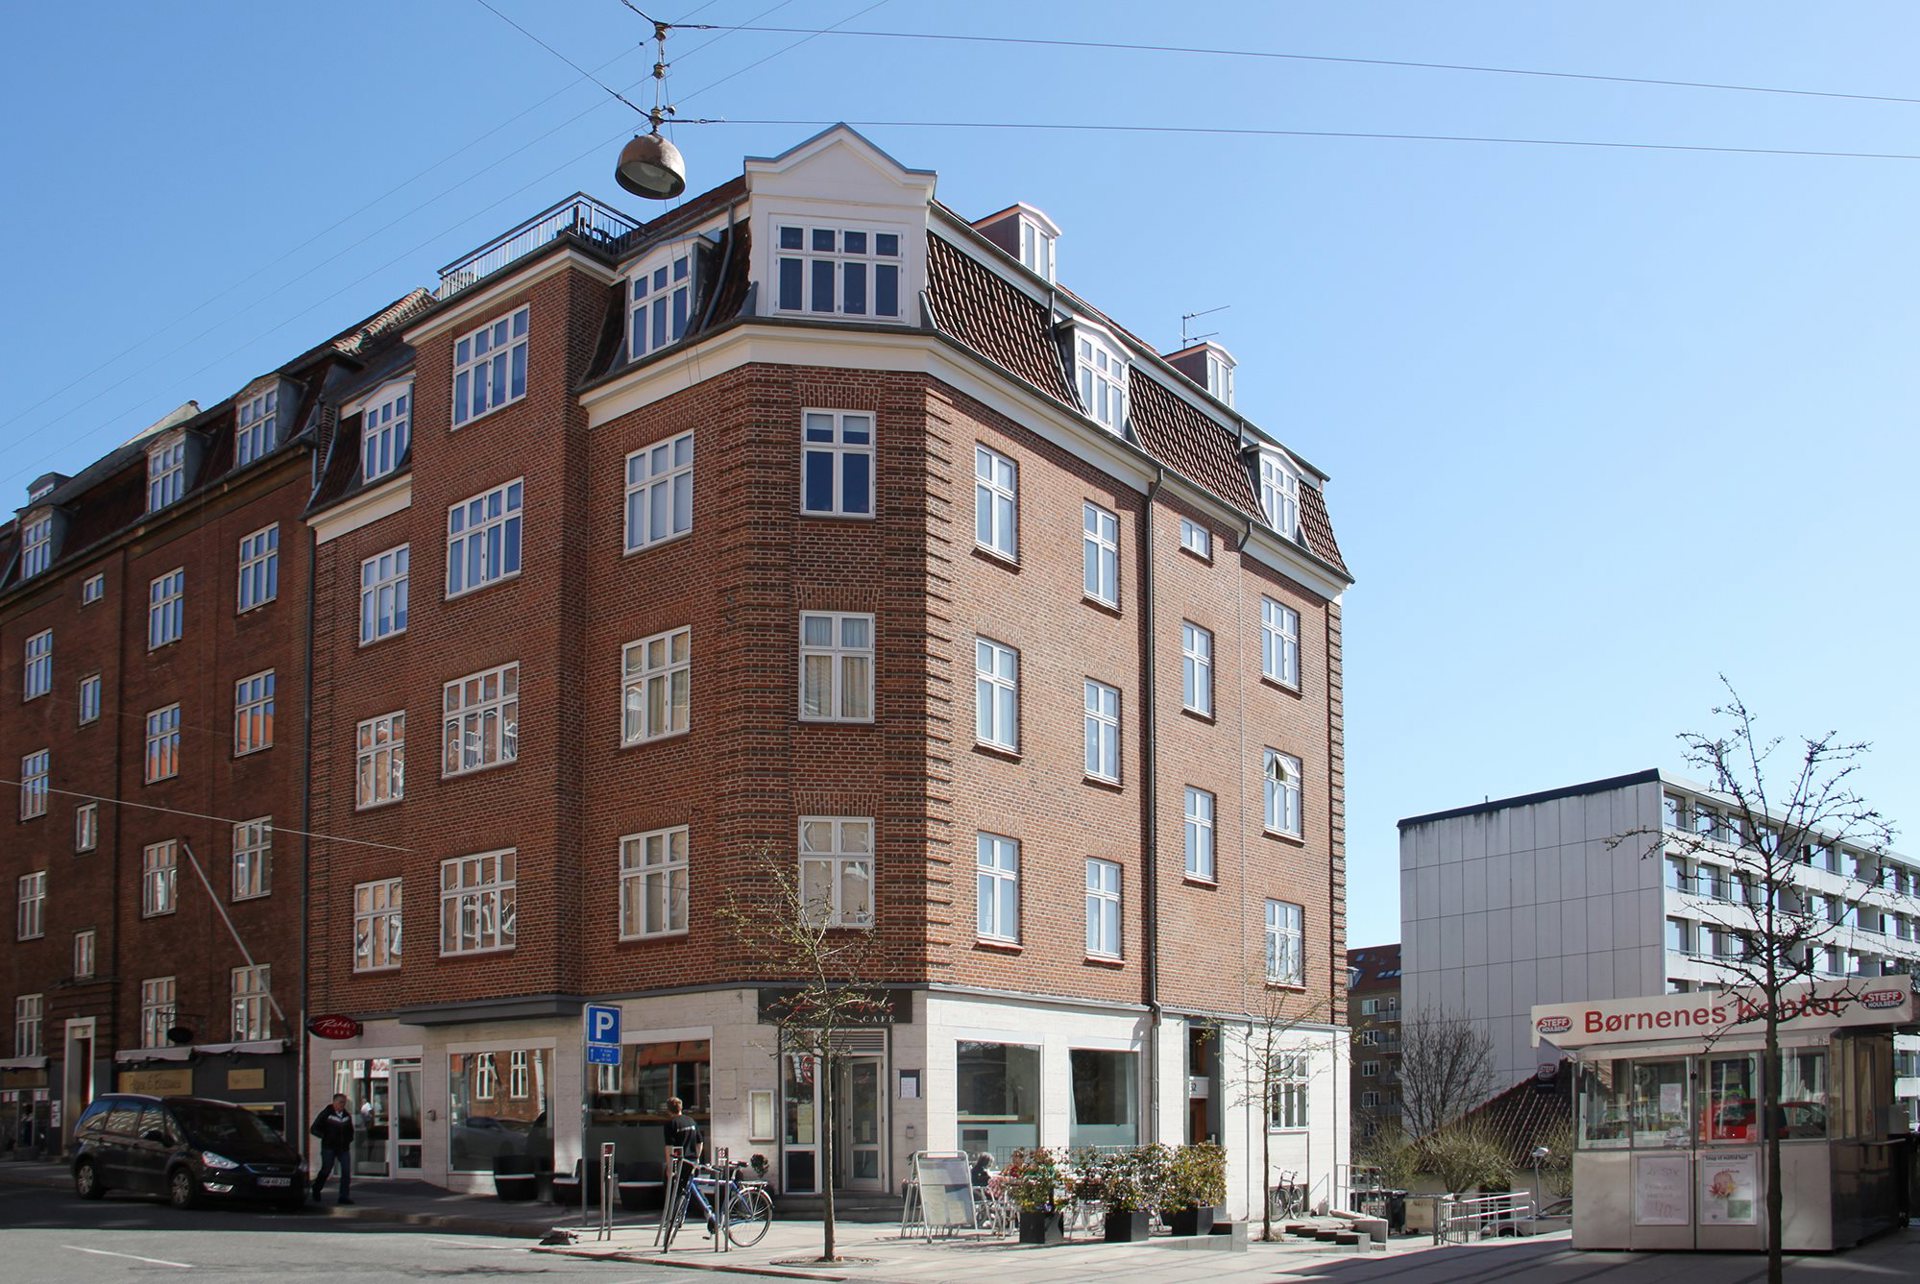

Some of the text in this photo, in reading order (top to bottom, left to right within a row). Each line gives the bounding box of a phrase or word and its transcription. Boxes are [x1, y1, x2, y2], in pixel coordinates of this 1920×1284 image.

[1867, 991, 1899, 1002] STEFF
[596, 1011, 615, 1040] P
[1541, 1018, 1568, 1027] STEFF
[1584, 1004, 1727, 1033] Børnenes
